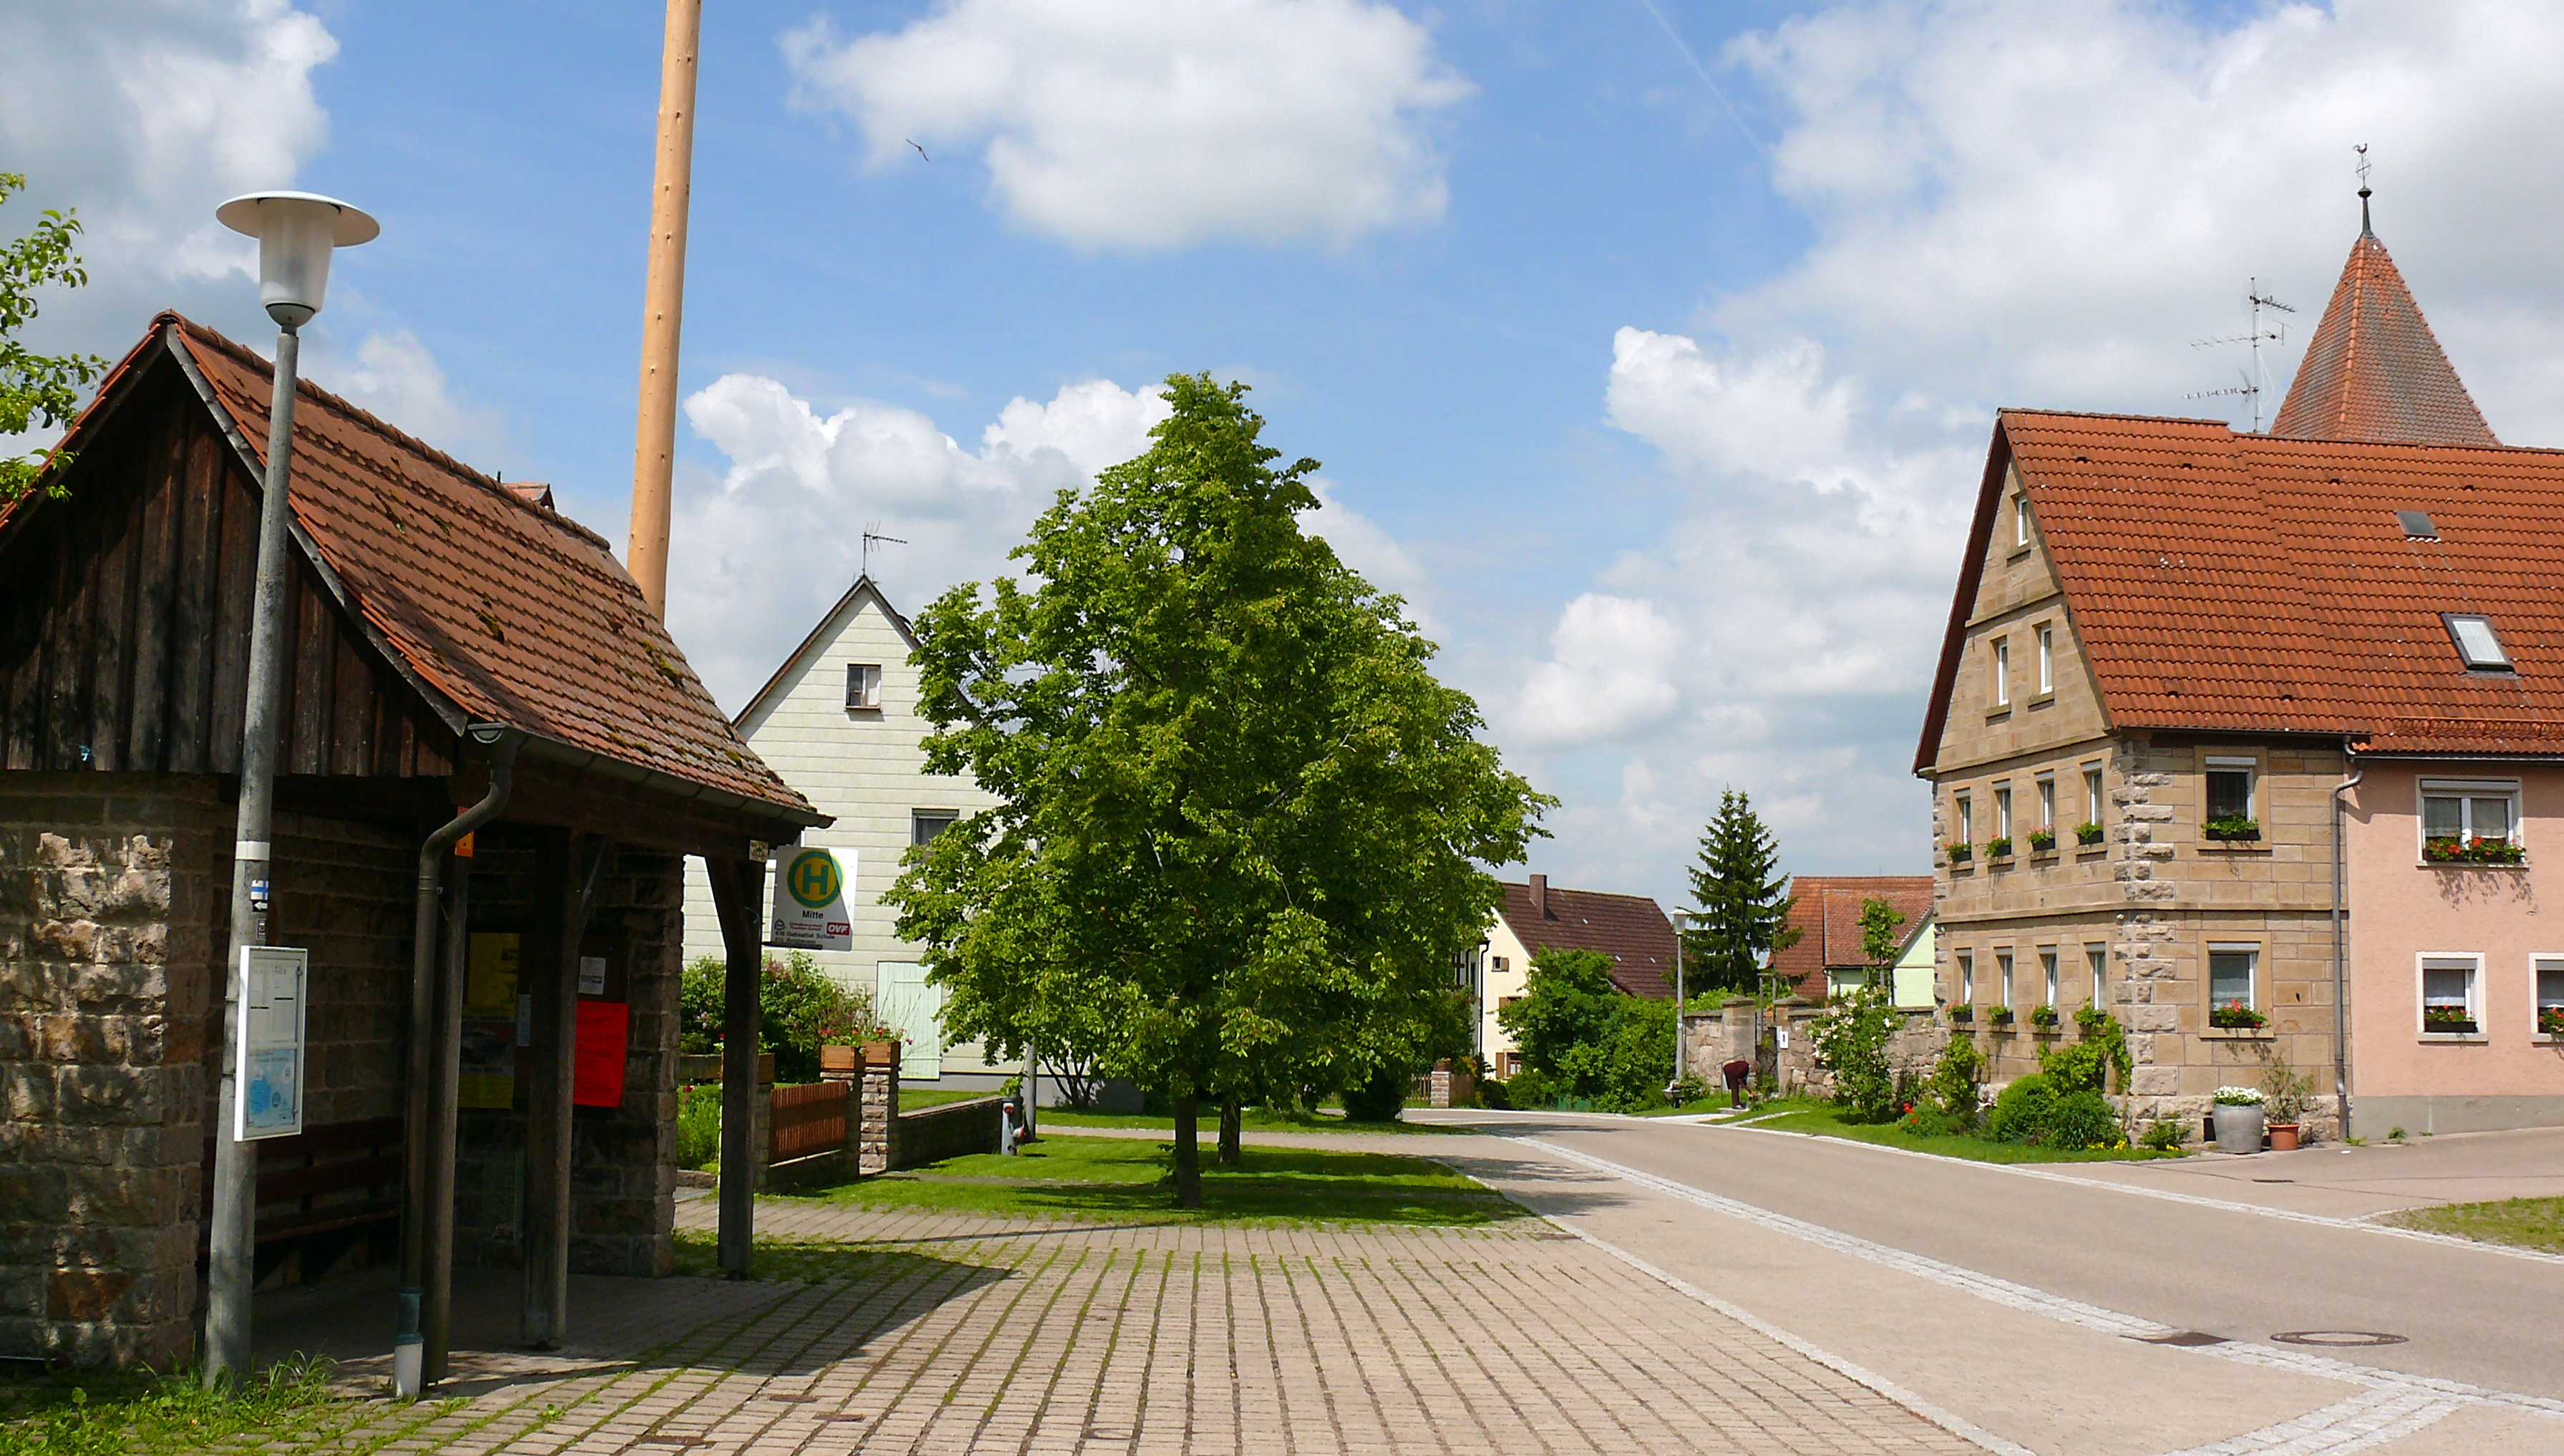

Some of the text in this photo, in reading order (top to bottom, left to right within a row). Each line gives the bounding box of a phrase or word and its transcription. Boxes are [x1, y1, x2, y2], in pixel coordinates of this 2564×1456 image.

[803, 864, 829, 895] H
[802, 910, 823, 919] Mitte
[827, 924, 849, 933] OVF
